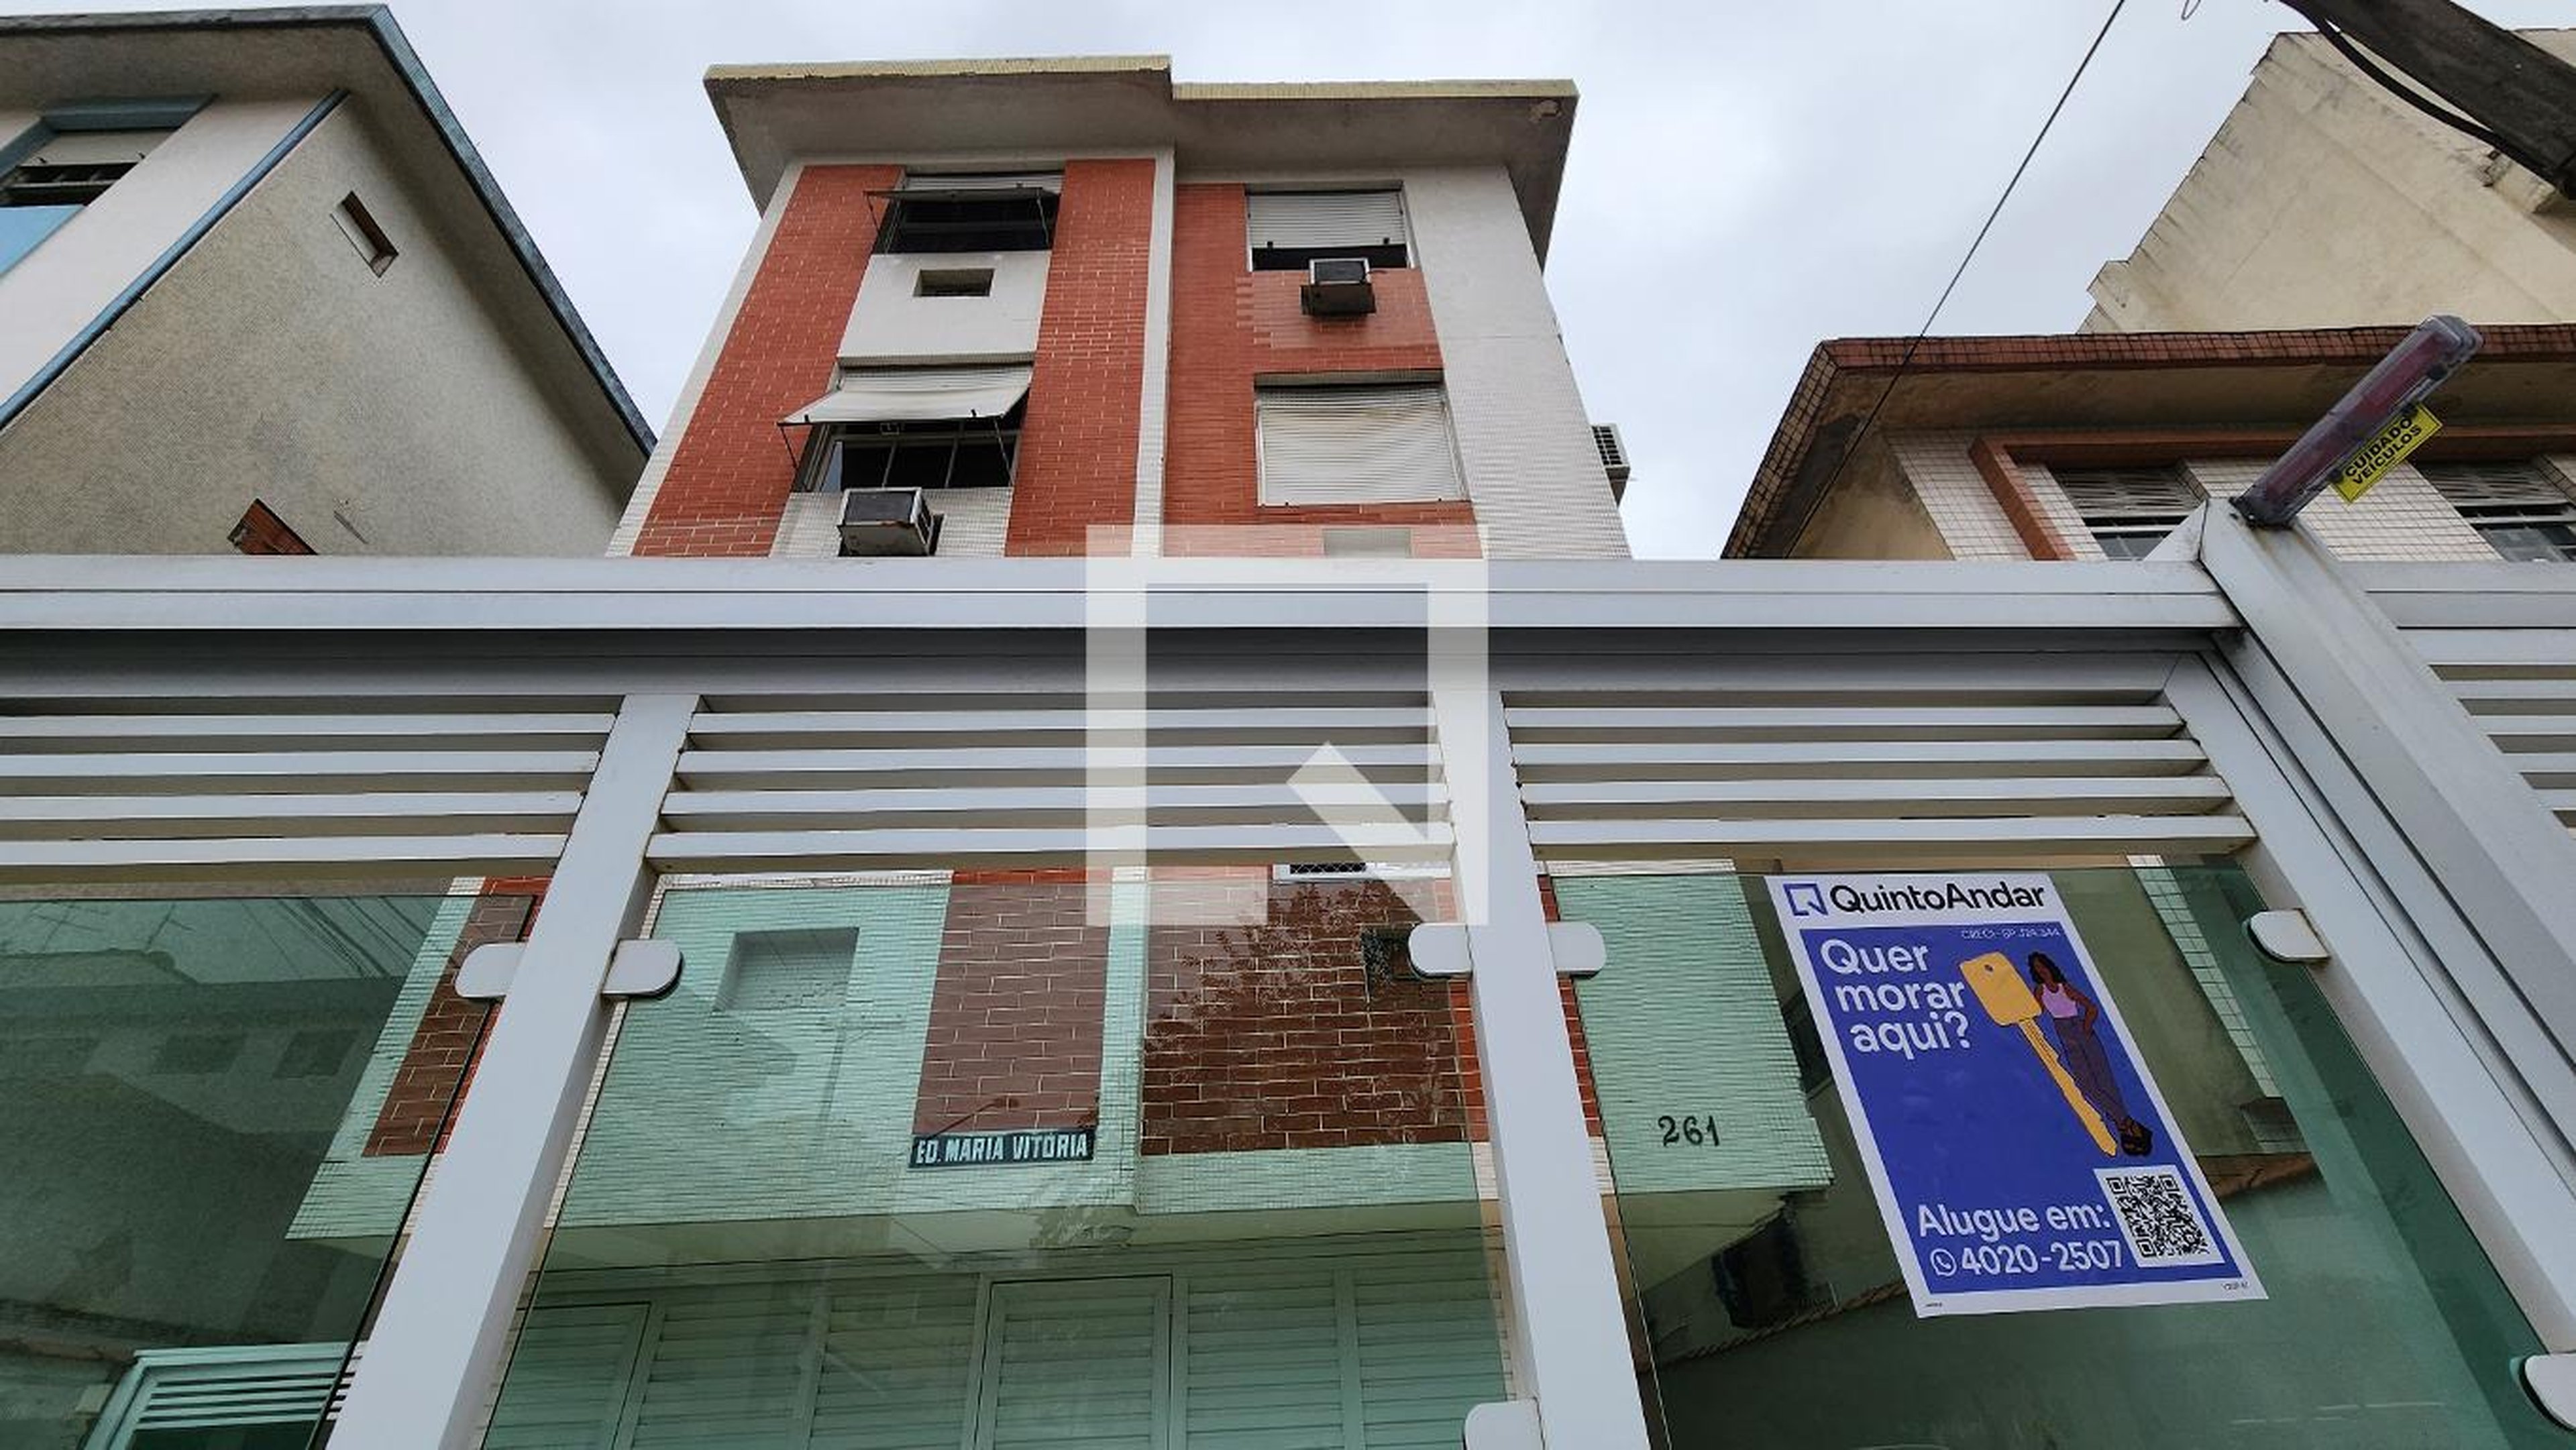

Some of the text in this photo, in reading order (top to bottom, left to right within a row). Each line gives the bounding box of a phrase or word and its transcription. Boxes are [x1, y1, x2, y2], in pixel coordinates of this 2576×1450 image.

[2345, 418, 2412, 477] CUIDADO
[1829, 881, 2045, 913] QuintoAndar
[1820, 939, 1929, 974] Quer
[1835, 981, 1965, 1012] morar
[1849, 1010, 1971, 1060] aqui?
[1658, 1115, 1720, 1147] 261
[916, 1140, 941, 1164] ED.
[945, 1137, 1004, 1163] MARIA
[1918, 1204, 2111, 1242] Alugue em:
[1962, 1240, 2123, 1275] 4020-2507
